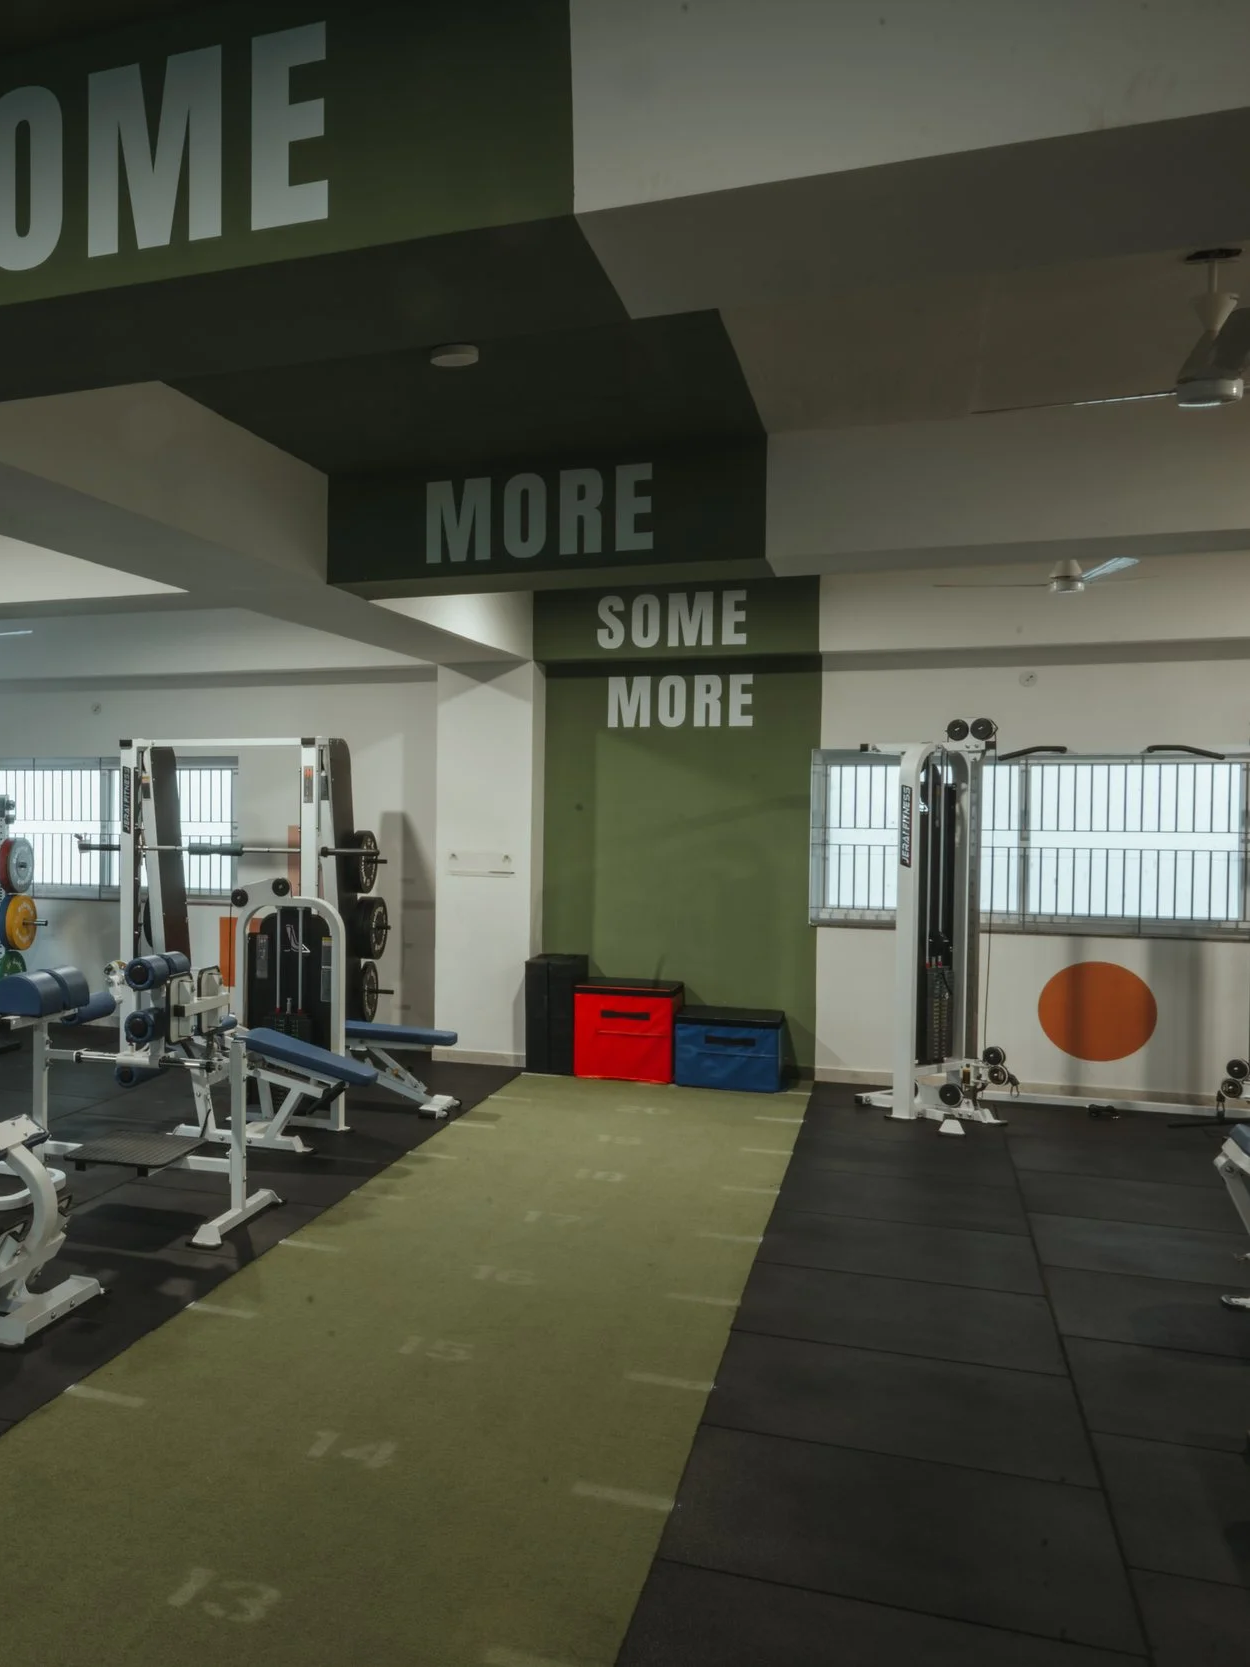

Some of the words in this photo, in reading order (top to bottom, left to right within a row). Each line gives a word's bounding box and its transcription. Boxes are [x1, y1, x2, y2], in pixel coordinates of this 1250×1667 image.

[424, 463, 655, 564] MORE
[596, 589, 748, 650] SOME
[606, 673, 755, 728] MORE
[902, 786, 910, 830] FITNESS
[902, 832, 910, 864] JERAI
[523, 1209, 583, 1225] 17
[471, 1263, 538, 1286] 16
[398, 1335, 475, 1362] 15
[304, 1429, 399, 1469] 14
[166, 1566, 282, 1623] 13
